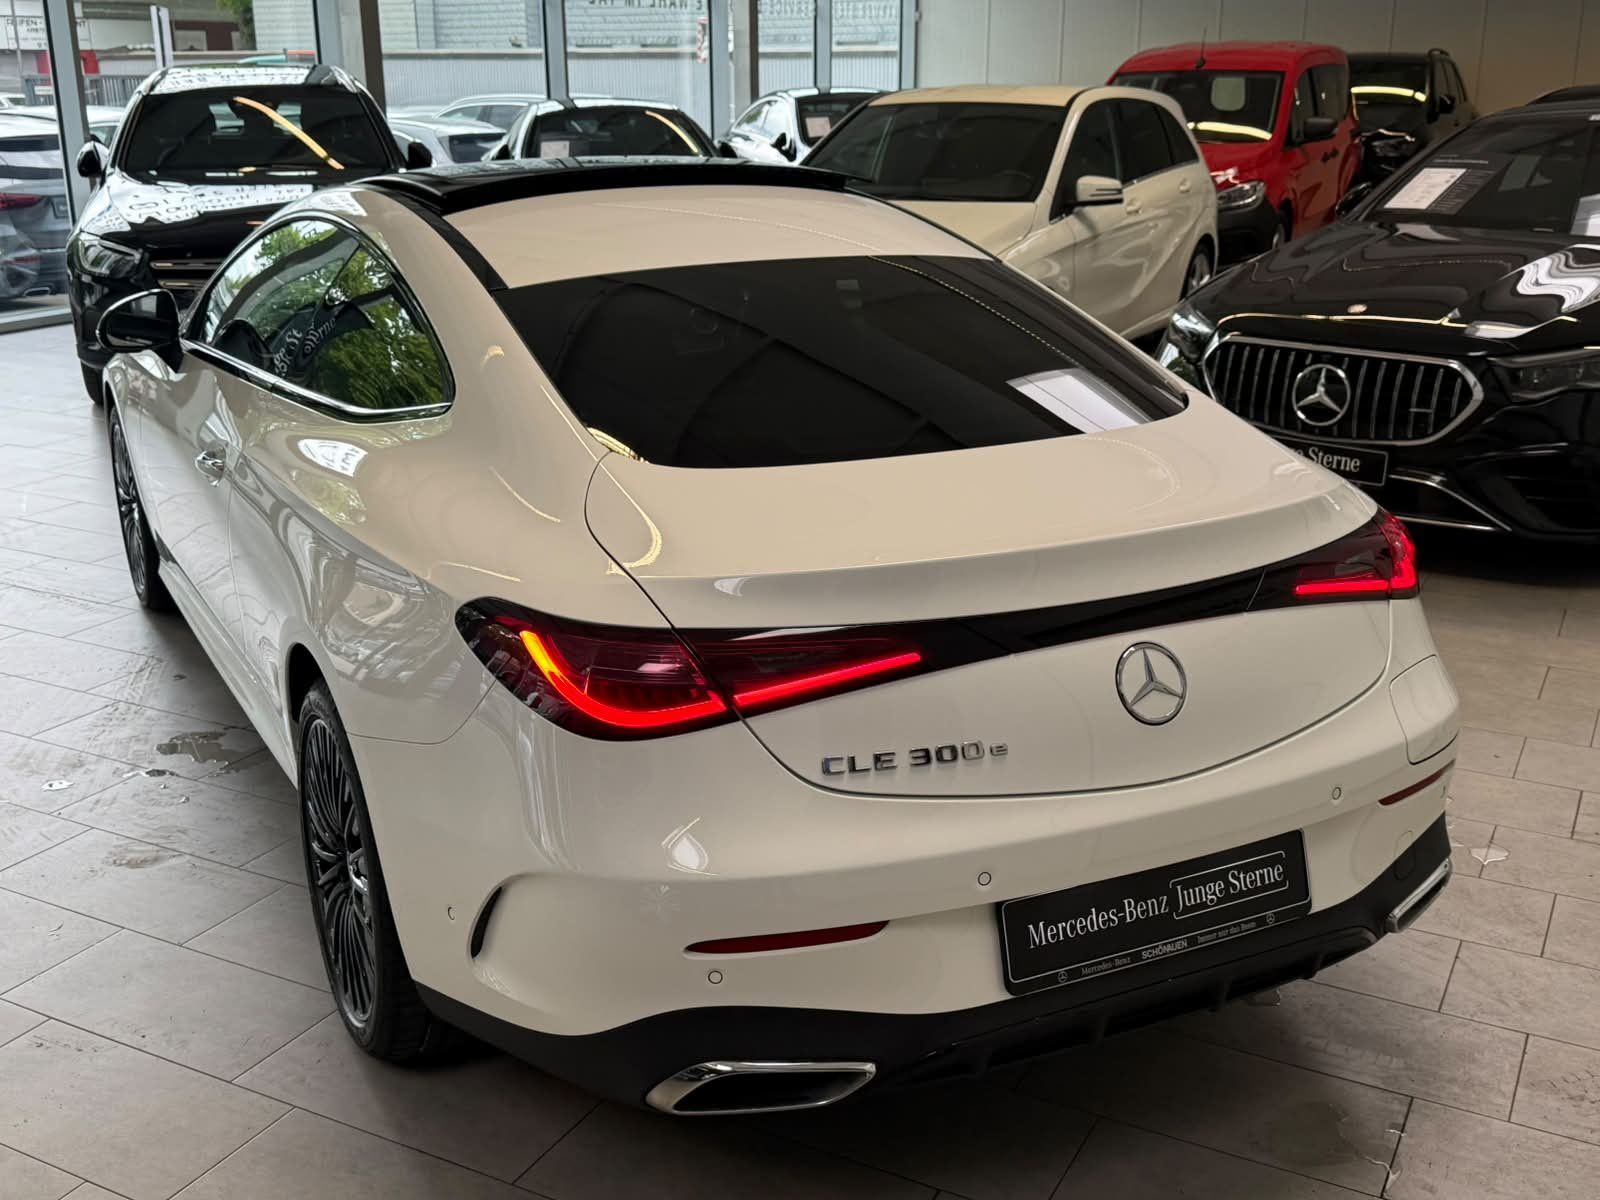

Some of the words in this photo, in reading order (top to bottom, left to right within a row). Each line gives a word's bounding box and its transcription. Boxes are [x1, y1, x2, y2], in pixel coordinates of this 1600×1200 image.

[1308, 446, 1361, 473] Sterne
[822, 752, 898, 776] CLE
[1028, 895, 1170, 949] Mercedes-Benz
[1175, 880, 1226, 912] Junge
[1227, 863, 1285, 895] Sterne
[1081, 956, 1132, 976] Mercedes-Benz
